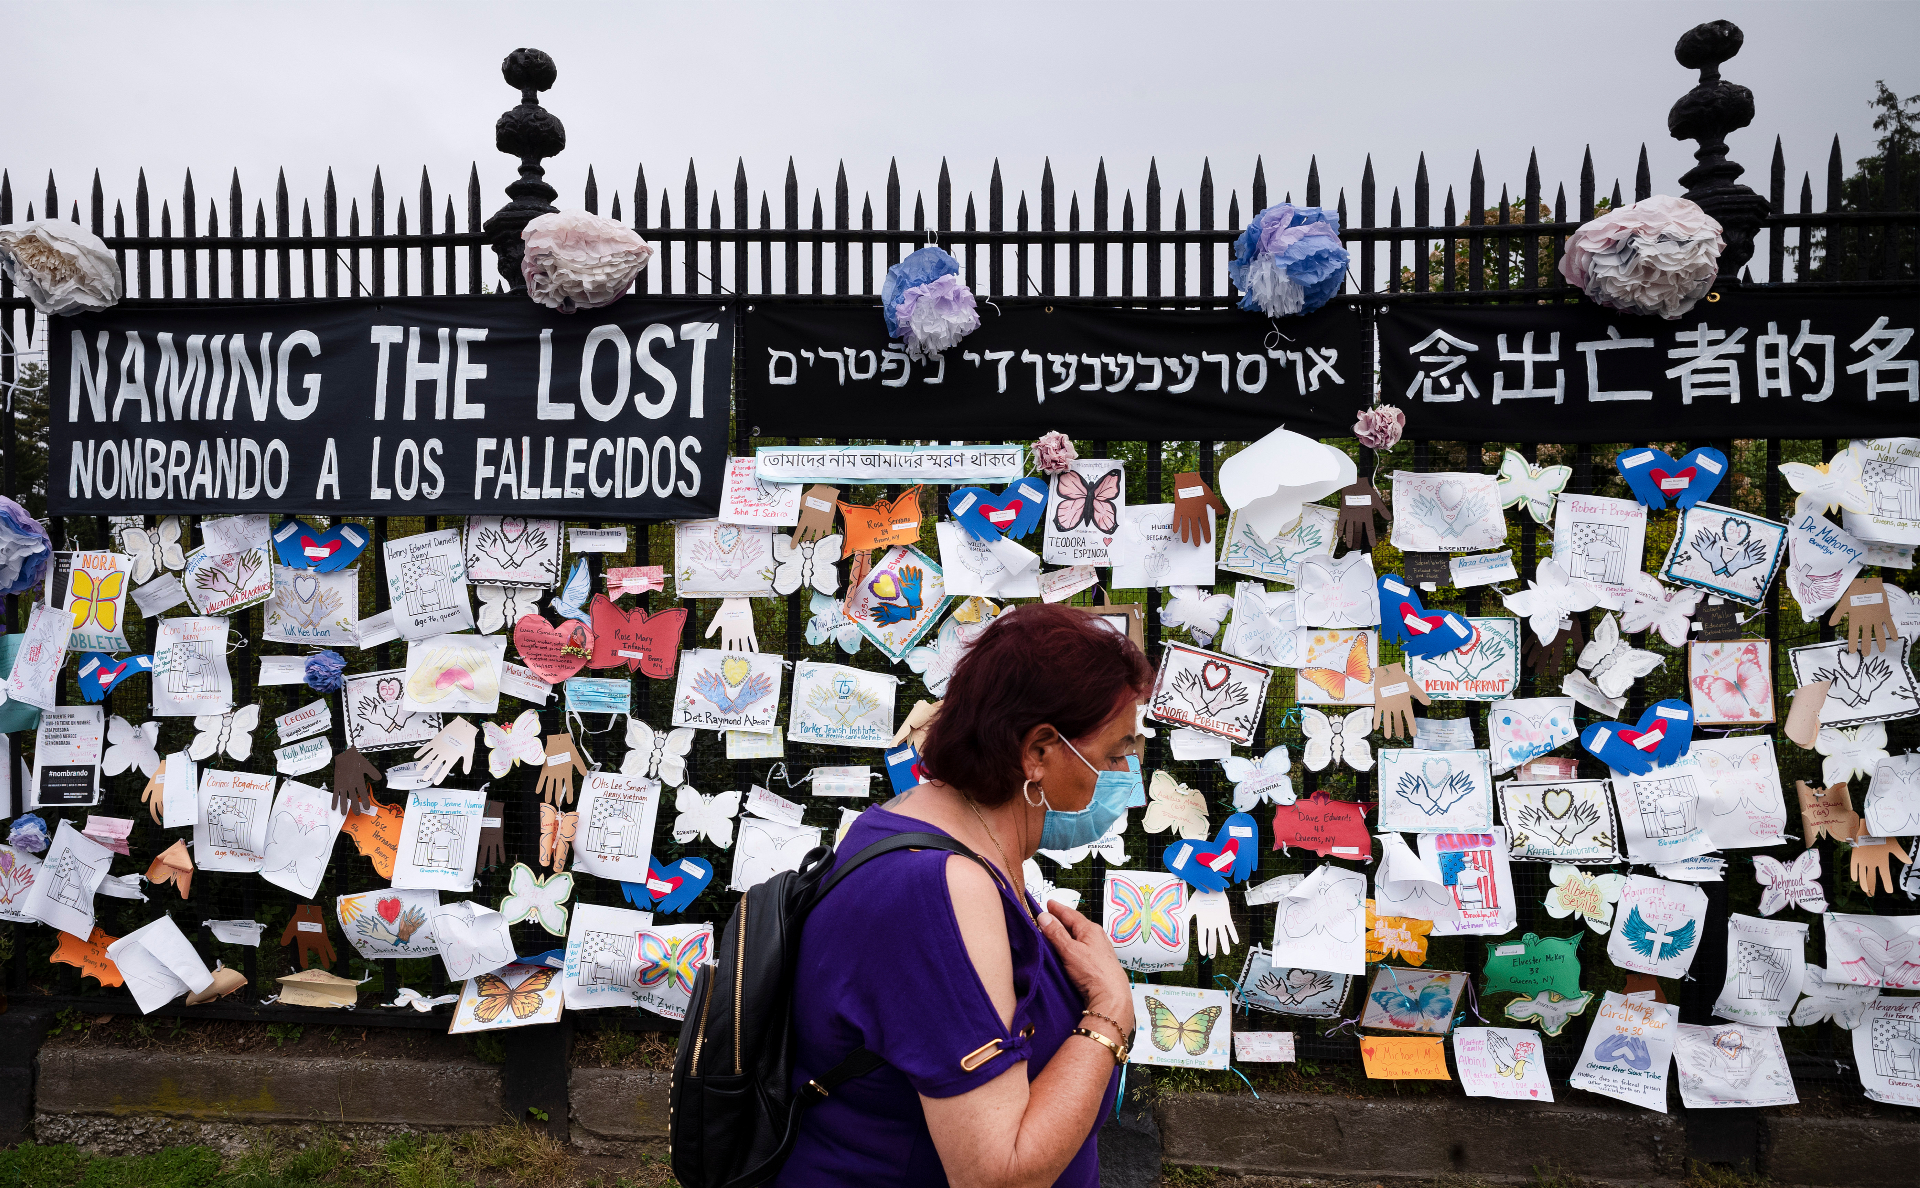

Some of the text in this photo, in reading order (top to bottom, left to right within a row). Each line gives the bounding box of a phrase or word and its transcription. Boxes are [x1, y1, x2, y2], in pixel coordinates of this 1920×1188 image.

[1408, 315, 1920, 406] 念出亡者的名
[69, 323, 720, 423] NAMING THE LOST
[69, 438, 290, 500] NOMBRANDO
[316, 437, 341, 500] A
[371, 437, 445, 500] LOS
[475, 436, 702, 500] FALLECIDOS
[763, 453, 826, 469] তোমাদের
[829, 453, 858, 468] নাম
[860, 453, 924, 469] আমাদের
[970, 452, 1017, 468] থাকবে
[1571, 501, 1607, 514] Robert
[1047, 537, 1107, 558] TEODORA ESPINOSA
[83, 553, 117, 571] NORA
[205, 594, 239, 615] VALENTINA
[69, 633, 127, 649] OBLETE
[1425, 679, 1510, 692] KEVIN TARRANT
[1161, 705, 1236, 733] NORA POBLETE
[610, 778, 622, 790] Lee
[411, 797, 438, 809] Bishop
[1298, 812, 1319, 822] Dave
[1559, 879, 1599, 902] Alberto
[1621, 884, 1665, 903] Raymond
[1561, 894, 1602, 914] Sevilla
[1452, 920, 1484, 932] Vietnam
[1542, 976, 1555, 985] NY
[632, 991, 655, 1005] Scott
[1620, 997, 1655, 1014] Andrea
[1867, 1000, 1910, 1012] Alexander
[1600, 1003, 1668, 1030] Circle Bear
[1615, 1025, 1644, 1036] age 30
[1643, 1071, 1662, 1080] Tribe
